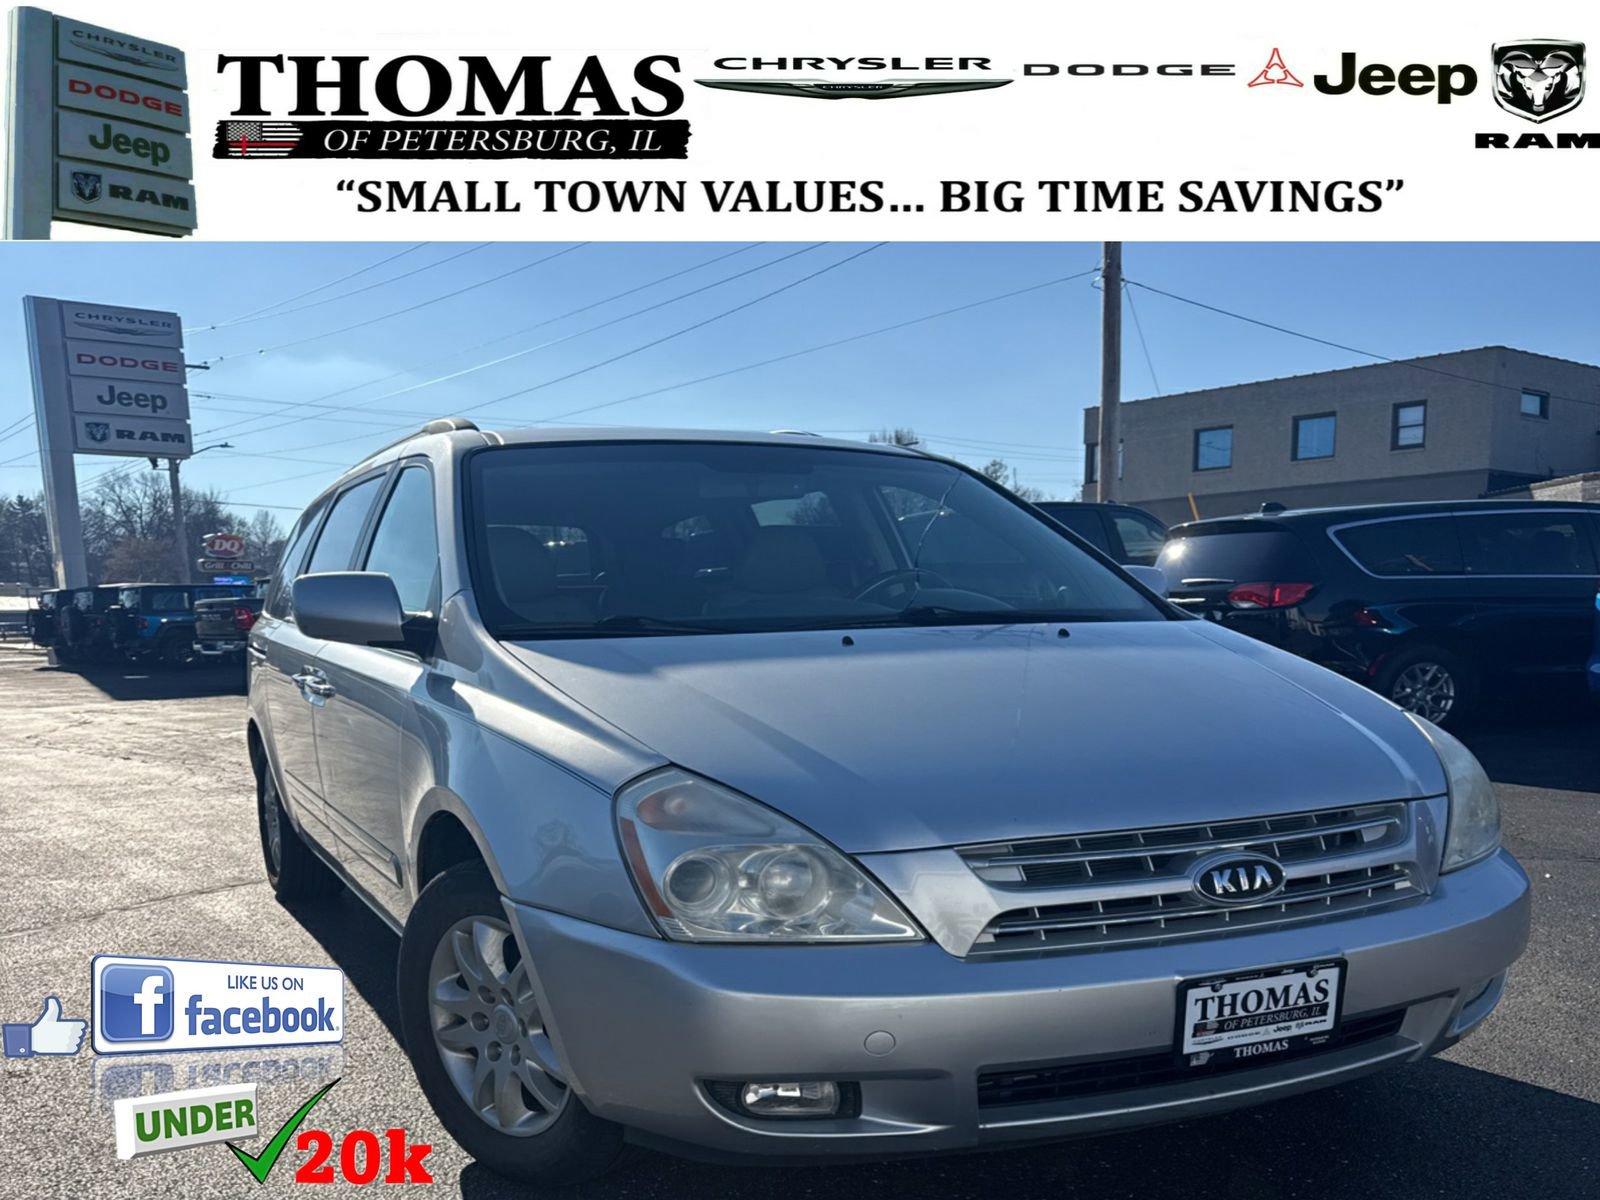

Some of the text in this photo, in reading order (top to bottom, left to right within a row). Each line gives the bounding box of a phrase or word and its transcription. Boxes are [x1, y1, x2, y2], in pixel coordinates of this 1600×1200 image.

[74, 312, 172, 329] CHRYSLER
[76, 353, 179, 373] DODGE
[97, 385, 168, 414] Jeep
[115, 429, 185, 444] RAM
[214, 539, 241, 553] DQ
[1210, 864, 1274, 895] KIA
[1195, 978, 1329, 1021] THOMAS
[1224, 1018, 1241, 1031] OF
[1311, 1005, 1322, 1016] IL
[1234, 1039, 1290, 1058] THOMAS
